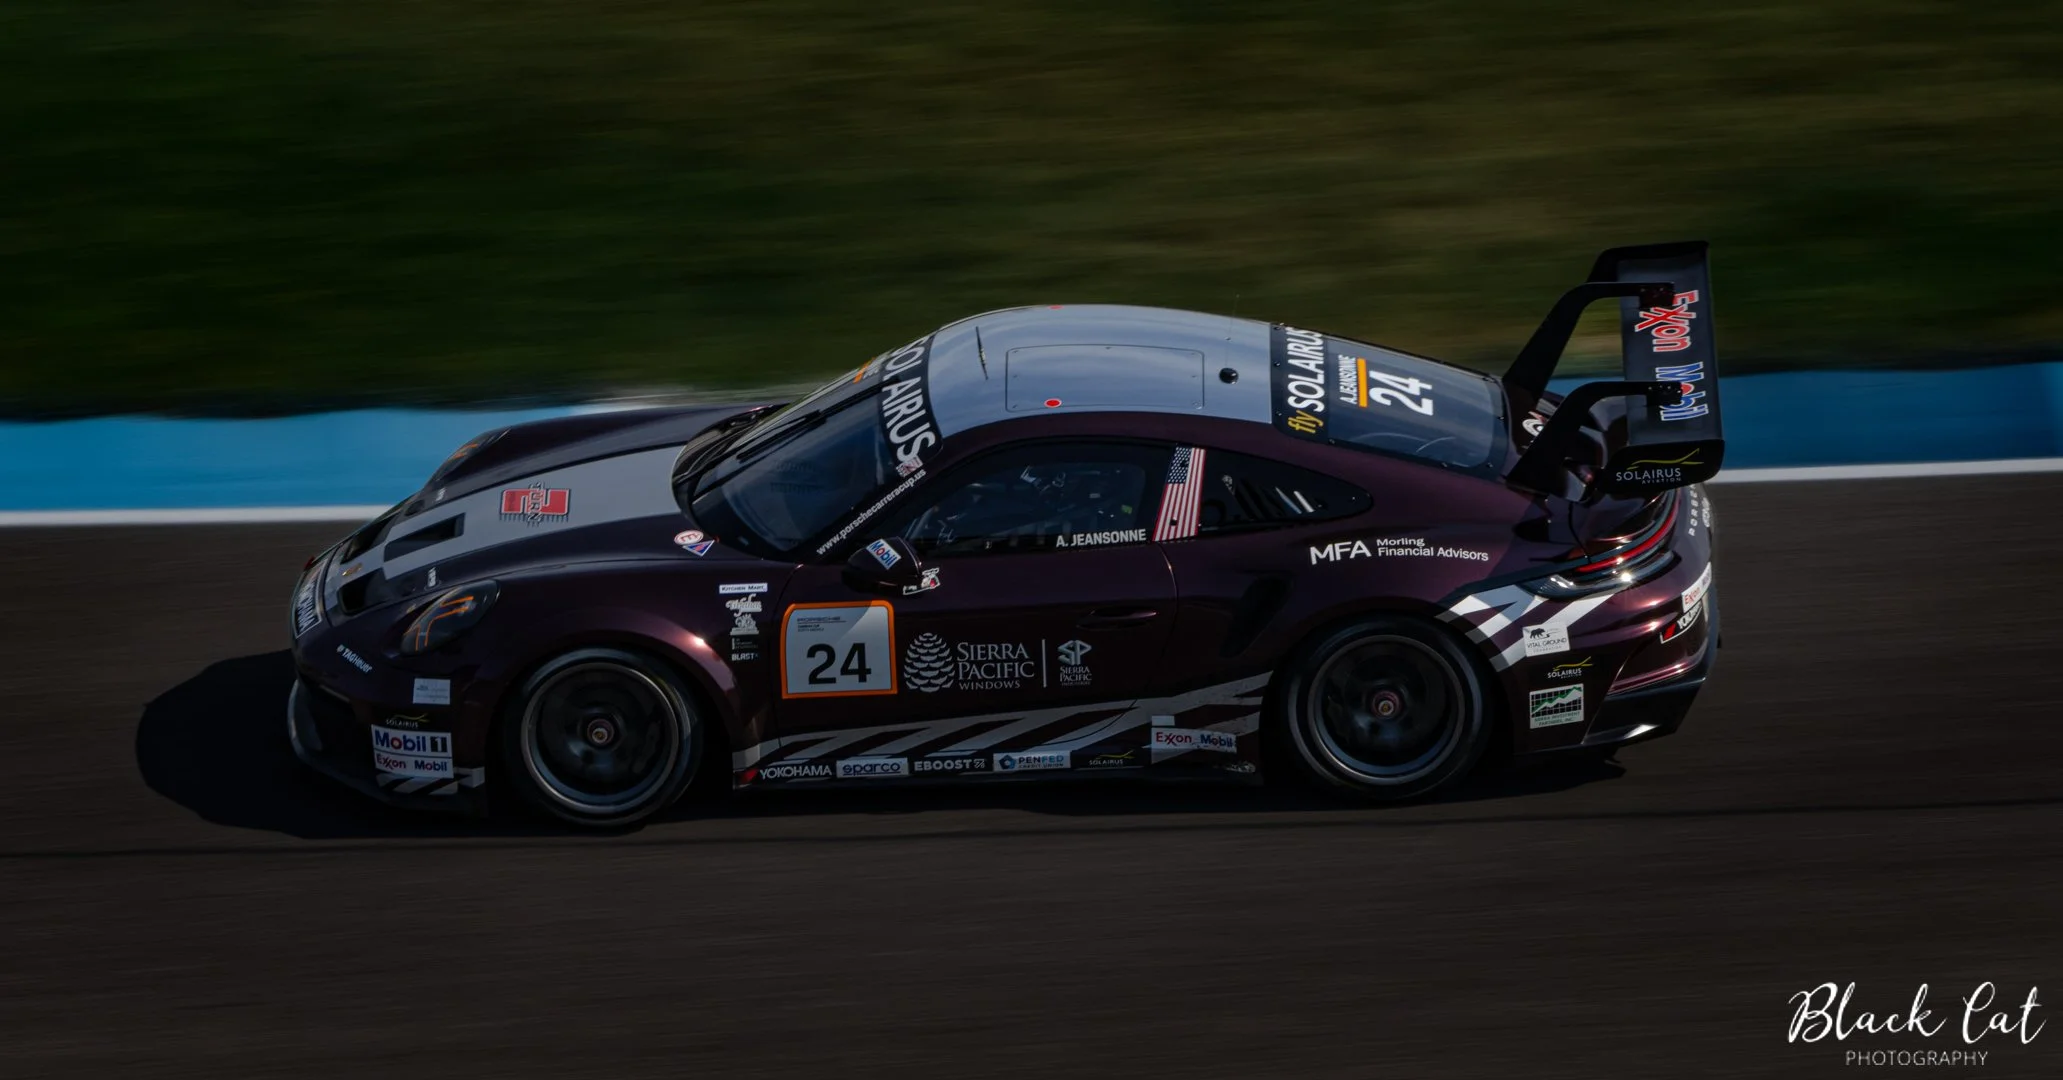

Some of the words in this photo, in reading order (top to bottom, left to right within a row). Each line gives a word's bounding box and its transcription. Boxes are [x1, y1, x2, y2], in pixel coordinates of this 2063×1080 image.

[1369, 370, 1434, 416] 24
[1287, 410, 1324, 434] fly
[1616, 468, 1681, 482] SOLAIRUS
[816, 468, 927, 556] www.porschecarreracup.us
[1056, 535, 1069, 548] A.
[1071, 528, 1147, 546] JEANSONNE
[1376, 538, 1425, 547] Morling
[870, 541, 897, 569] Mobil
[1309, 540, 1372, 566] MFA
[1377, 547, 1434, 557] Financial
[1437, 547, 1489, 561] Advisors
[1542, 638, 1567, 646] GROUND
[957, 643, 1030, 661] SIERRA
[806, 643, 872, 685] 24
[957, 661, 1035, 680] PACIFIC
[1060, 666, 1090, 674] SIERRA
[1060, 673, 1093, 682] PACIFIC
[1547, 668, 1583, 678] SOLAIRUS
[959, 680, 1021, 691] WINDOWS
[375, 730, 427, 752] Mobil
[430, 736, 448, 753] 1
[1156, 732, 1193, 746] Exxon
[1200, 734, 1233, 748] Mobil
[376, 754, 407, 770] Exxon
[414, 760, 448, 771] Mobil
[914, 759, 973, 771] EBOOST
[1018, 755, 1065, 764] PENFED
[759, 765, 833, 780] YOKOHAMA
[842, 762, 901, 775] sparco
